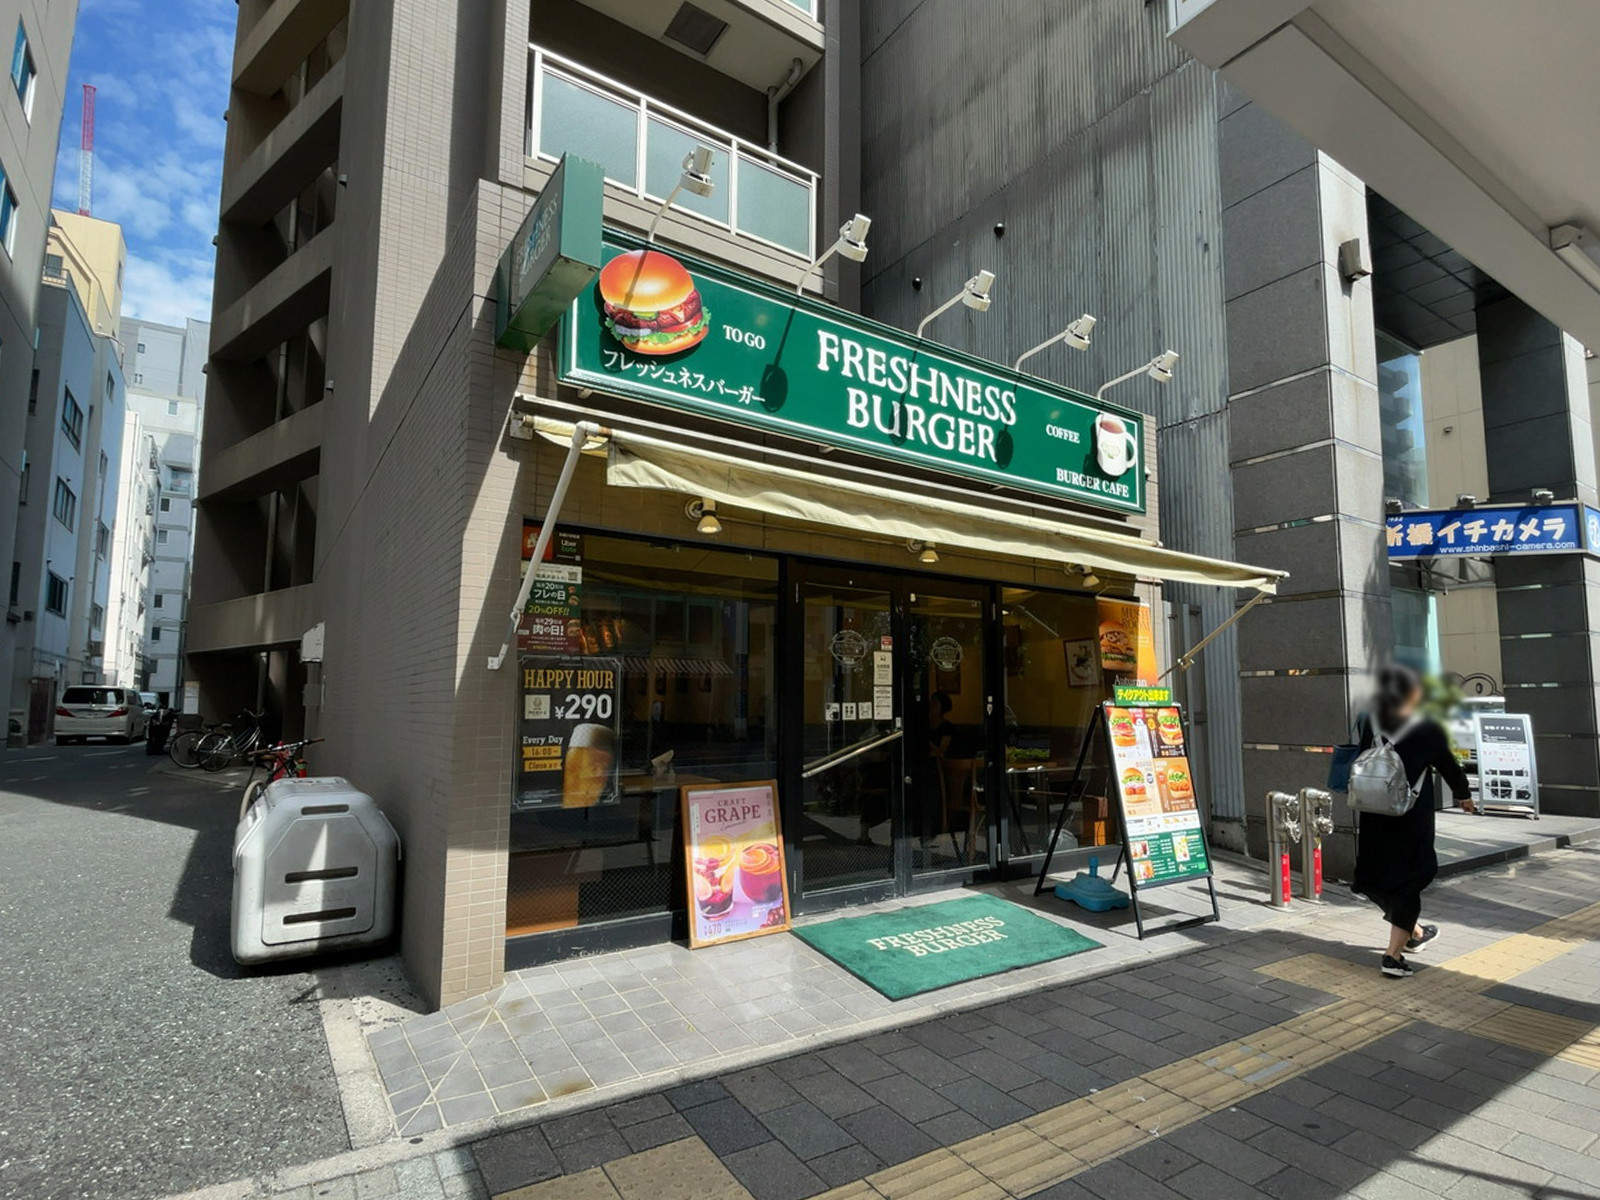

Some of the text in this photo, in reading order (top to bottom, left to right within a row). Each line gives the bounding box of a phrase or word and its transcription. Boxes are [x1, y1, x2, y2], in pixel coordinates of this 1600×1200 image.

[723, 325, 766, 350] TO GO
[602, 349, 766, 405] フレッシュネスバーガー
[817, 330, 1016, 426] FRESHNESS
[847, 388, 997, 462] BURGER
[1045, 424, 1080, 444] COFFEE
[1056, 467, 1129, 498] BURGER CAFE
[1439, 541, 1576, 553] www.shinbashi-camera.com
[533, 589, 566, 600] フレの日
[524, 669, 614, 689] HAPPY HOUR
[555, 694, 612, 719] ¥290
[523, 735, 564, 746] Every Day
[704, 804, 761, 824] GRAPE
[717, 798, 747, 807] CRAFT
[866, 916, 1005, 950] FRESHNESS
[902, 929, 1009, 957] BURGER
